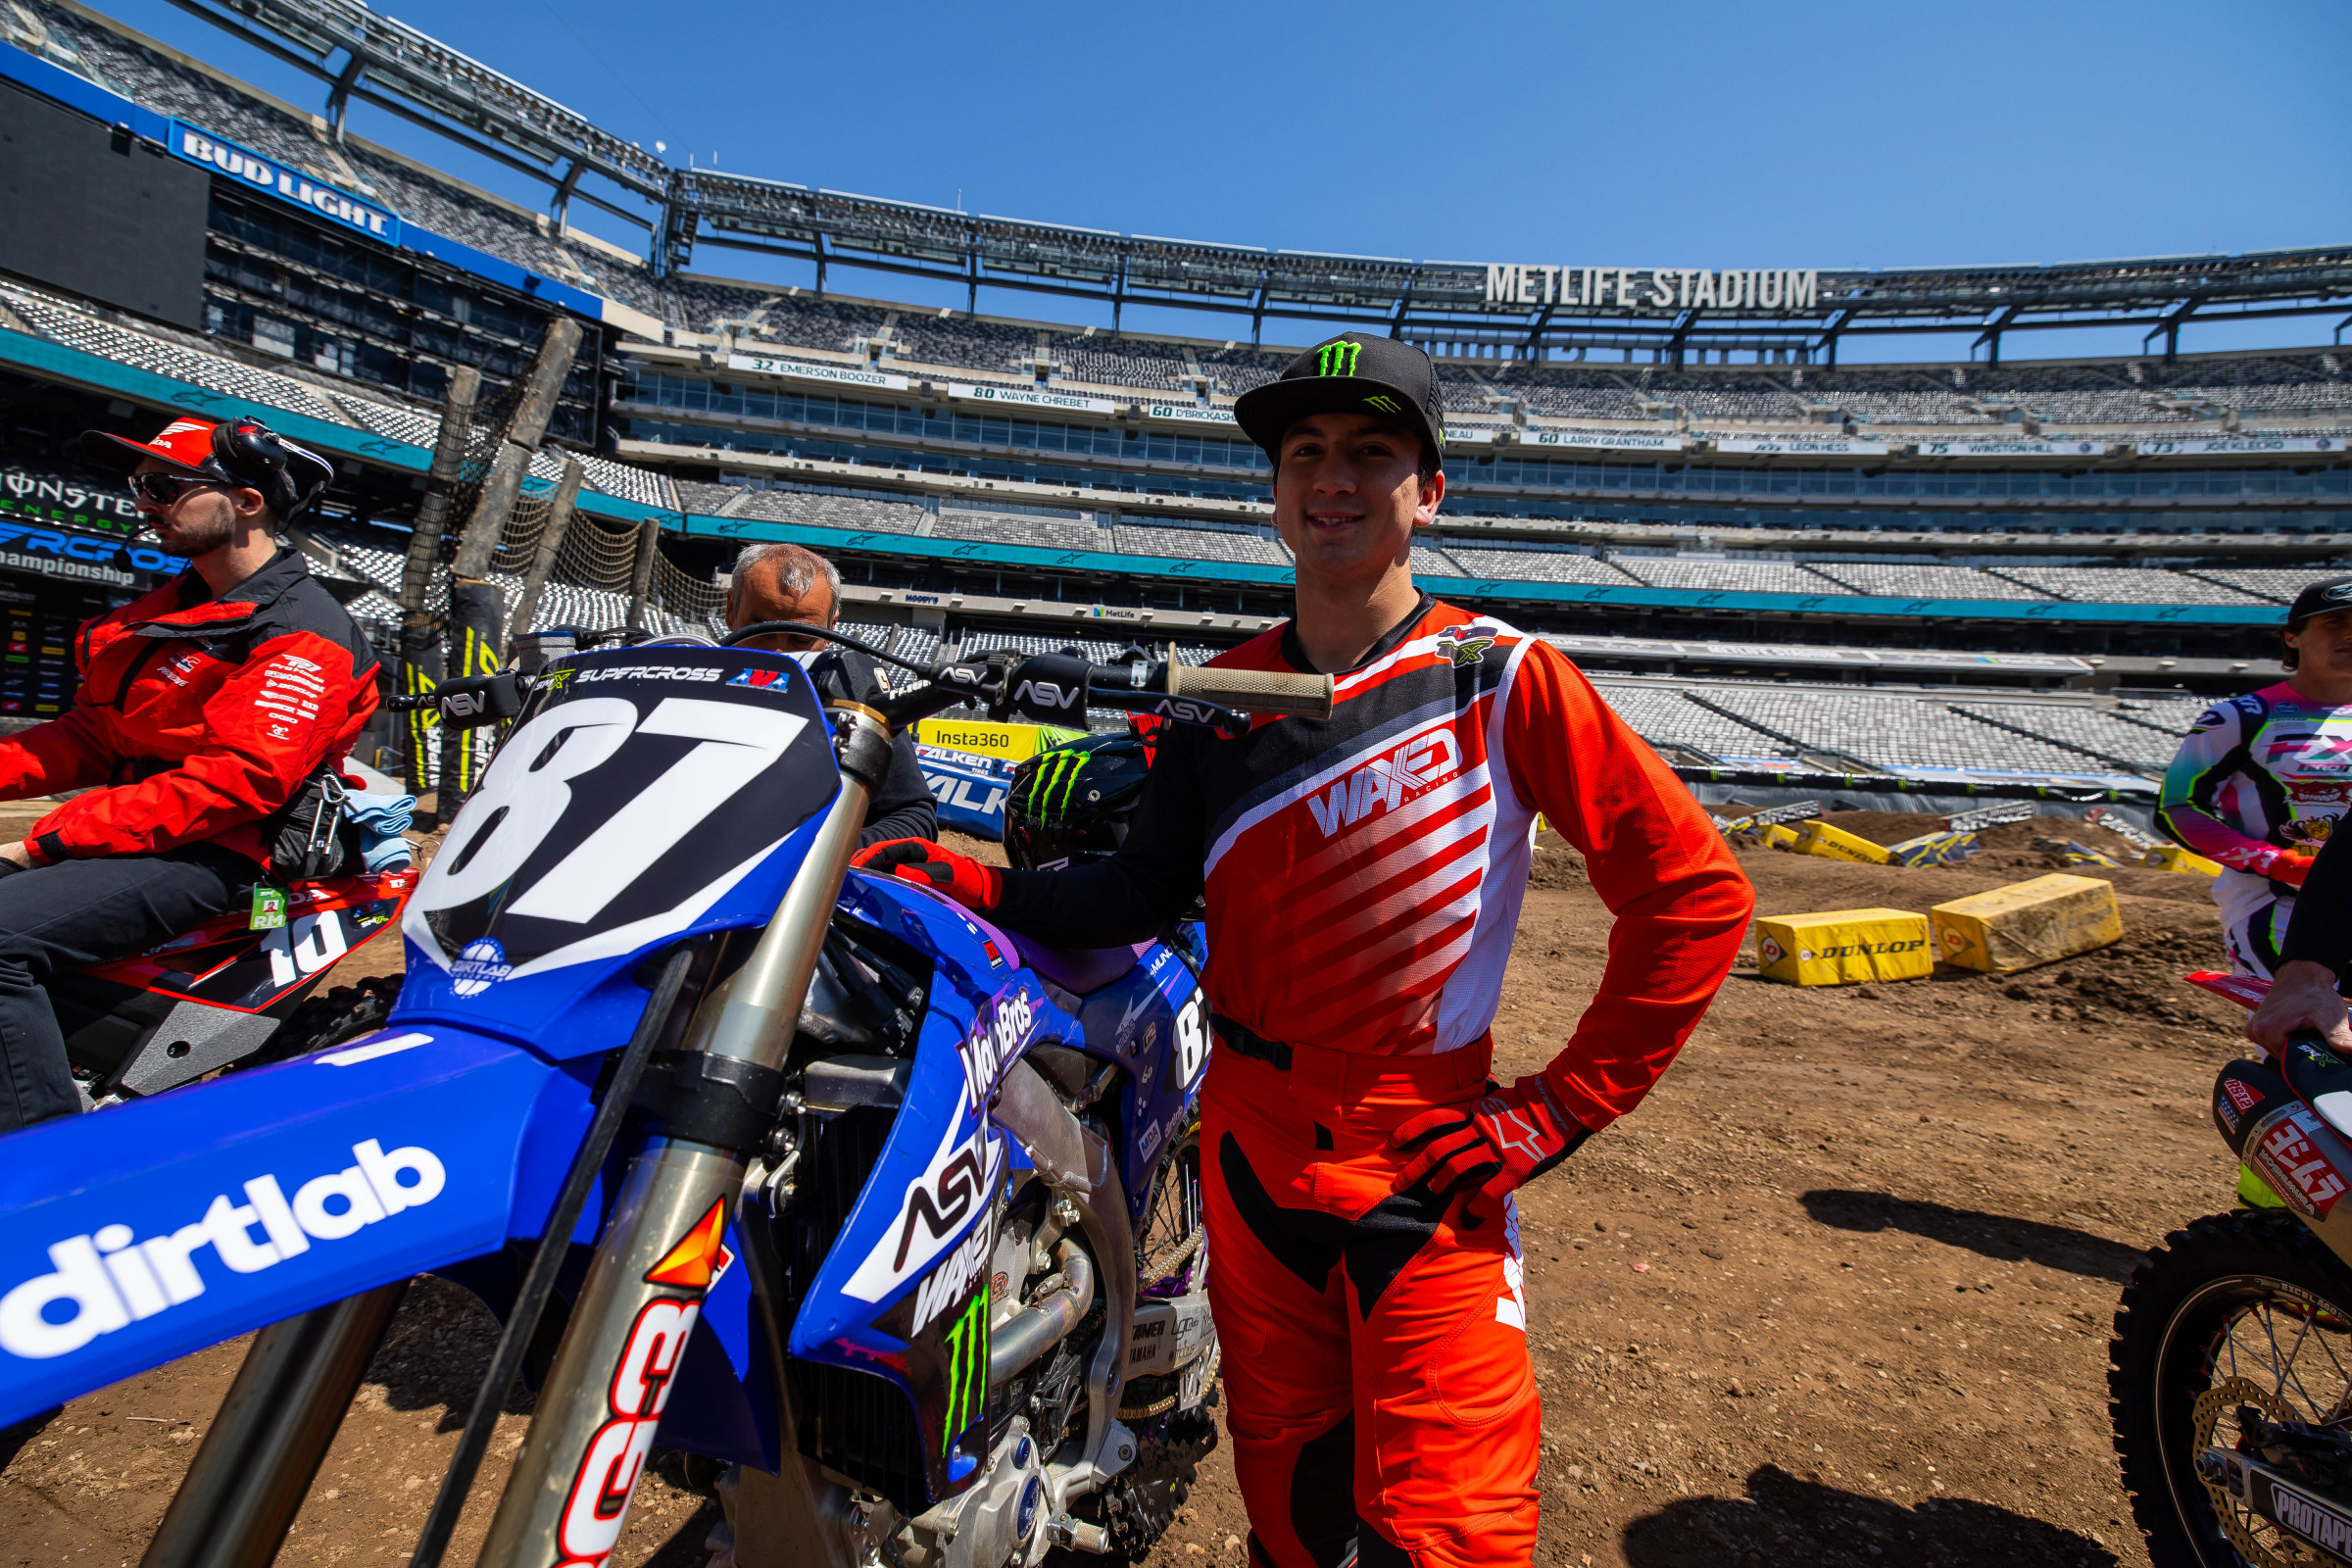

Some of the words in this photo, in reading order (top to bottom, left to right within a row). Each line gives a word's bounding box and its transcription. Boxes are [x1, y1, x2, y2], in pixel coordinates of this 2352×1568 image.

[183, 132, 273, 186] BUD
[277, 175, 387, 236] LIGHT
[1487, 263, 1640, 307] METLIFE
[1651, 269, 1818, 309] STADIUM
[752, 359, 773, 371] 32
[779, 364, 838, 379] EMERSON
[839, 370, 886, 385] BOOZER
[973, 387, 995, 399] 80
[1000, 391, 1040, 404] WAYNE
[1042, 395, 1090, 409] CHREBET
[1152, 406, 1173, 416] 60
[1176, 409, 1236, 421] D'BRICKASH
[1445, 429, 1474, 439] NEAU
[1539, 433, 1559, 444] 60
[1563, 434, 1598, 446] LARRY
[1600, 436, 1665, 448] GRANTHAM
[1930, 443, 1948, 453] 75
[0, 472, 146, 518] ONSTE
[0, 499, 133, 533] ENERGY
[0, 551, 135, 586] ampionship
[1105, 610, 1134, 618] MetLife
[574, 666, 724, 684] SUPERCROSS
[726, 667, 791, 691] AMA
[938, 666, 988, 685] ASV
[416, 695, 436, 708] AS
[441, 690, 485, 719] ASV
[1013, 679, 1080, 710] ASV
[1154, 699, 1215, 723] ASV
[936, 730, 1009, 748] Insta360
[914, 745, 993, 769] FALKEN
[1404, 771, 1458, 804] RACING
[406, 697, 809, 924] 87
[254, 914, 283, 929] RM
[260, 910, 347, 987] 10
[1820, 939, 1926, 959] DUNLOP
[451, 960, 514, 977] DIRTLAB
[1140, 1125, 1159, 1153] MDA
[2260, 1148, 2316, 1215] YOSHIMURA
[0, 1138, 446, 1359] dirtlab
[2280, 1282, 2316, 1304] EXCEL
